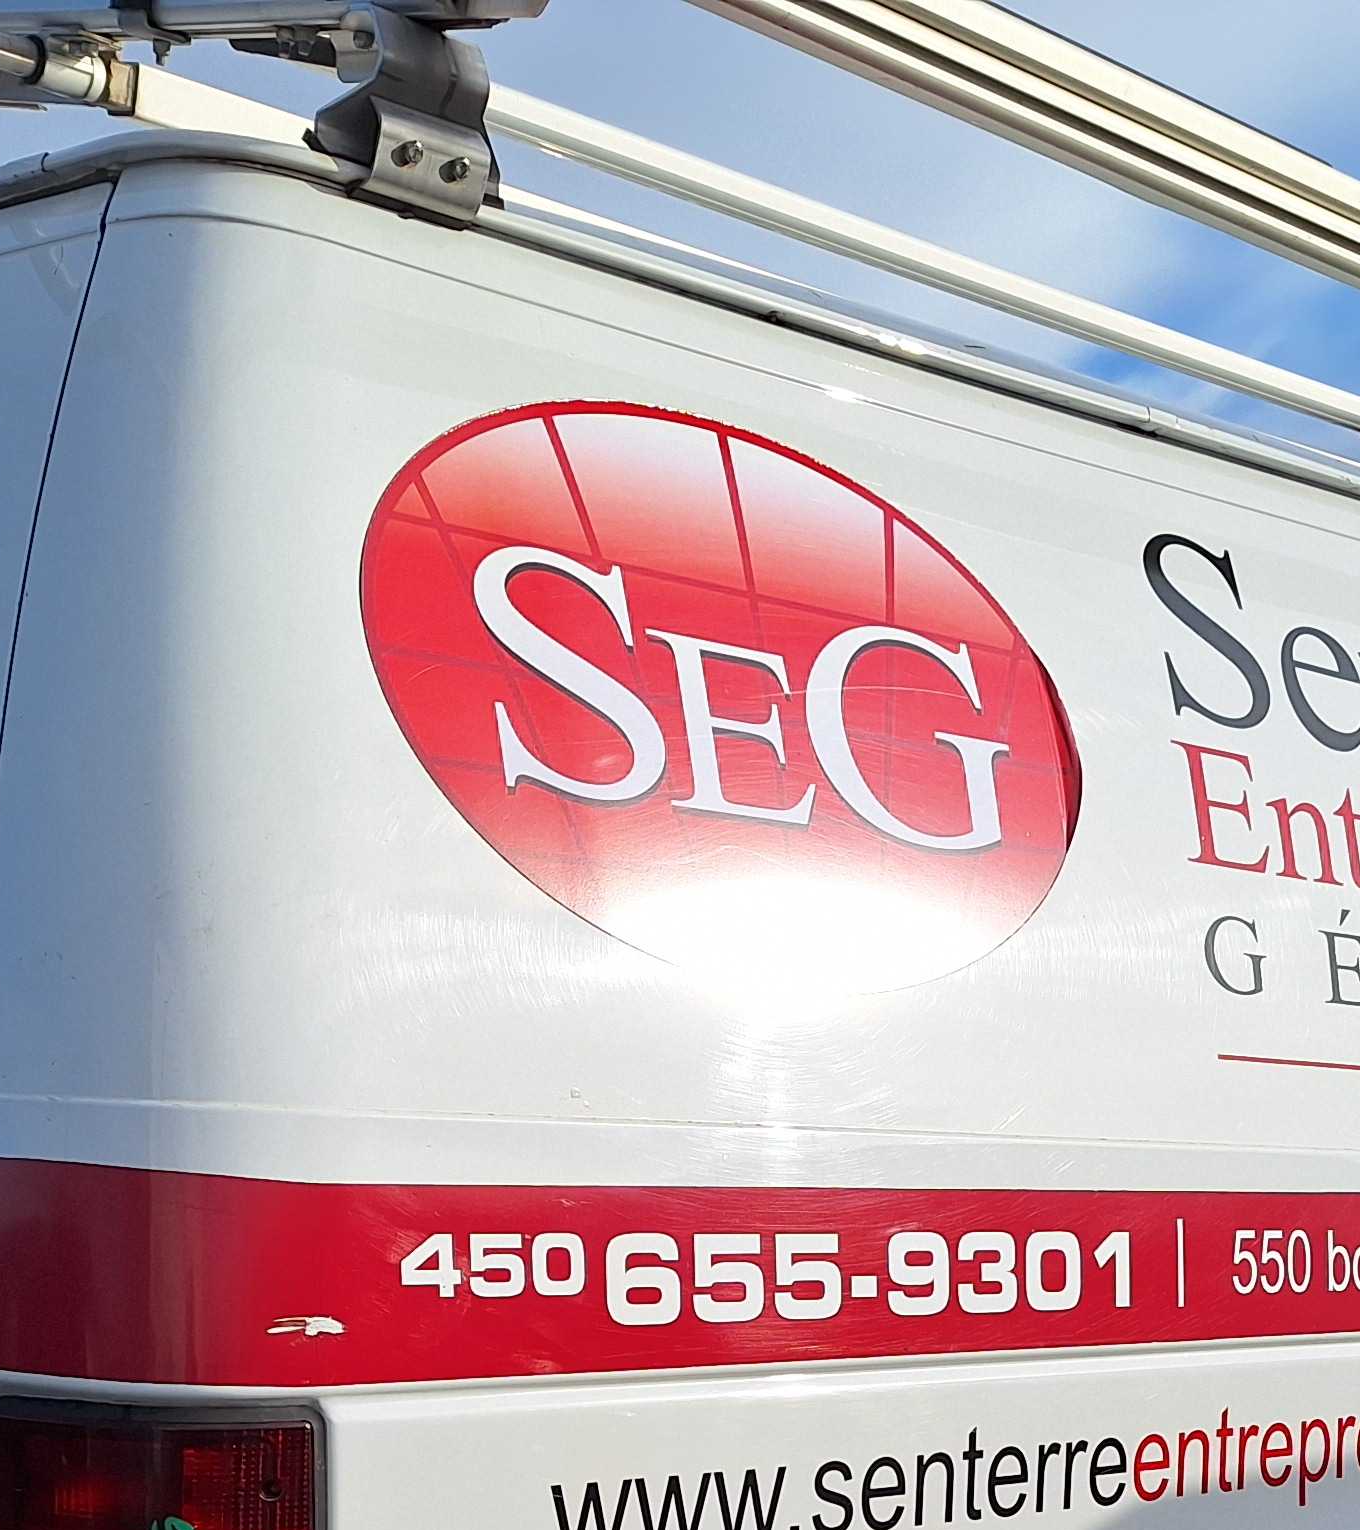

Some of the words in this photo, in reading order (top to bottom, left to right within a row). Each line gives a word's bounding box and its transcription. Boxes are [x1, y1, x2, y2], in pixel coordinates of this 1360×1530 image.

[472, 545, 1011, 854] SEG
[399, 1232, 586, 1298] 450
[605, 1230, 1132, 1326] 655-9301
[1232, 1229, 1312, 1295] 550
